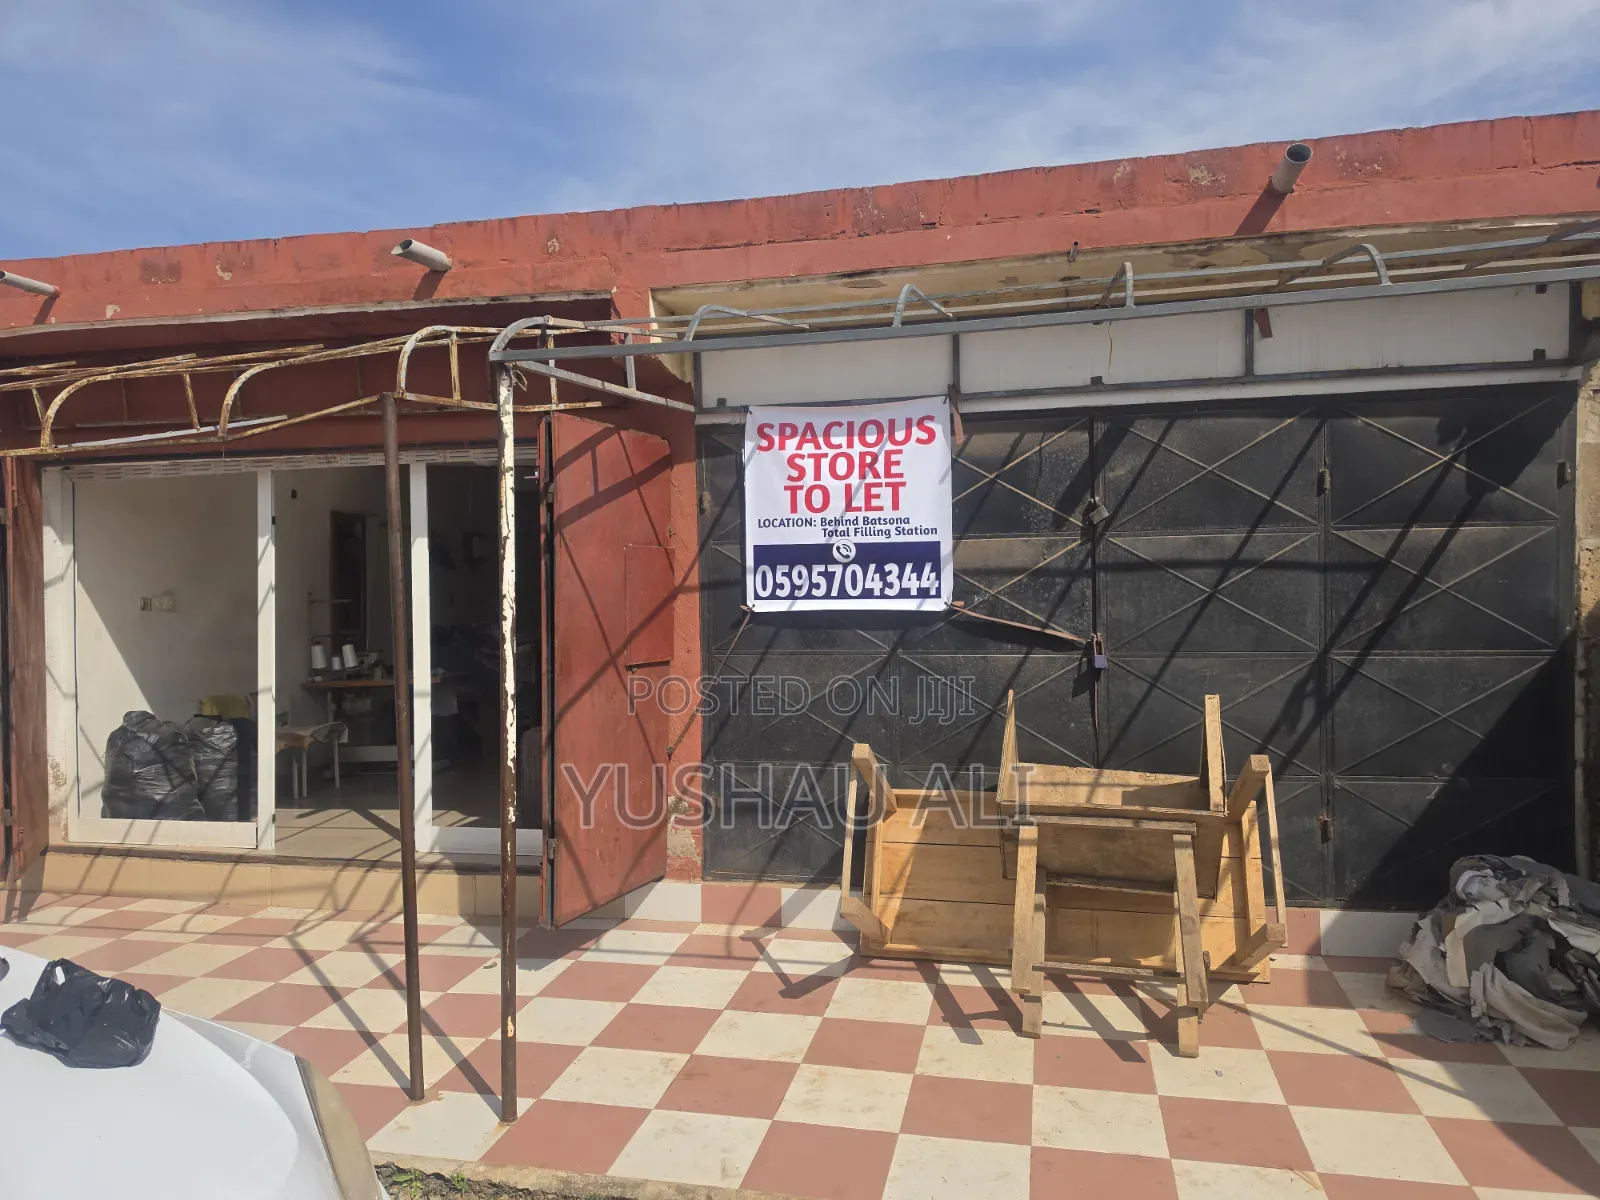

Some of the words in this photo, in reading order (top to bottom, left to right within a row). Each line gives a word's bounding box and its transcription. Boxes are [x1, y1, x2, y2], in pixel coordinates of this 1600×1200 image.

[756, 415, 937, 452] SPACIOUS
[786, 449, 905, 482] STORE
[784, 484, 831, 514] TO
[844, 481, 907, 513] LET
[758, 517, 817, 528] LOCATION:
[820, 516, 859, 527] Behind
[862, 515, 910, 526] Batsona
[821, 527, 850, 538] Total
[853, 526, 891, 539] Filling
[894, 525, 938, 537] Station
[755, 562, 939, 597] 0595704344
